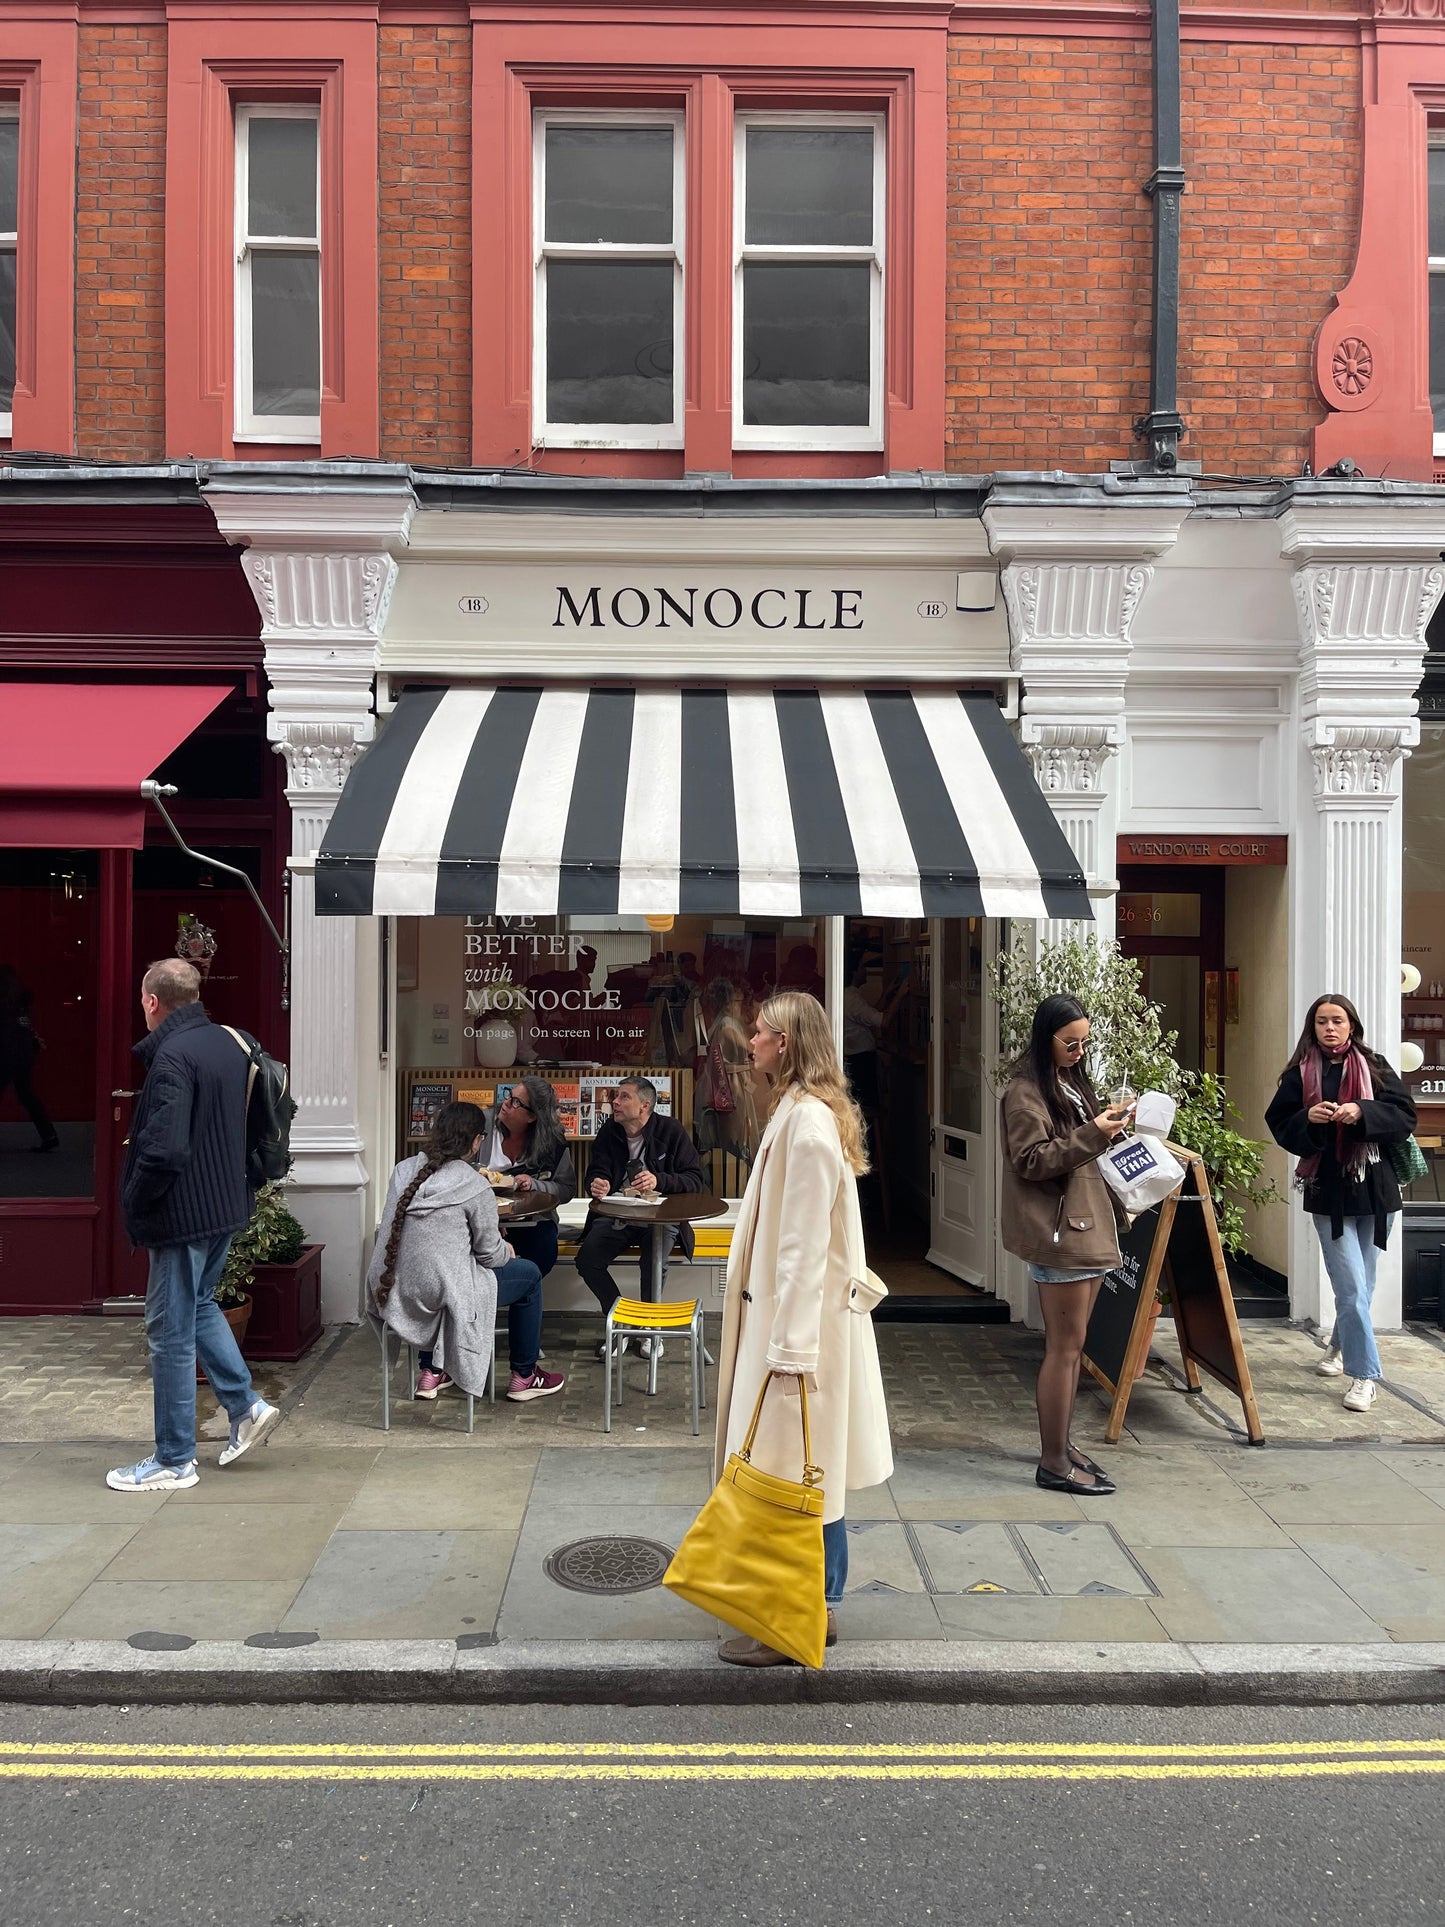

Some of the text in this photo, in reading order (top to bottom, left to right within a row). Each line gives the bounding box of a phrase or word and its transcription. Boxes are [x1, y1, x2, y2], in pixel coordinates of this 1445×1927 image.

[467, 599, 481, 611] 18
[552, 586, 864, 629] MONOCLE
[926, 604, 940, 616] 18
[1129, 842, 1269, 857] WENDOVER COURT
[464, 934, 588, 955] BETTER
[464, 962, 513, 983] with
[464, 989, 622, 1010] MONOCLE
[463, 1026, 645, 1040] On page On screen On air
[415, 1085, 449, 1093] MONOCLE
[459, 1091, 492, 1099] MONOCLE
[1120, 1153, 1153, 1176] THAI
[1130, 1255, 1140, 1273] for
